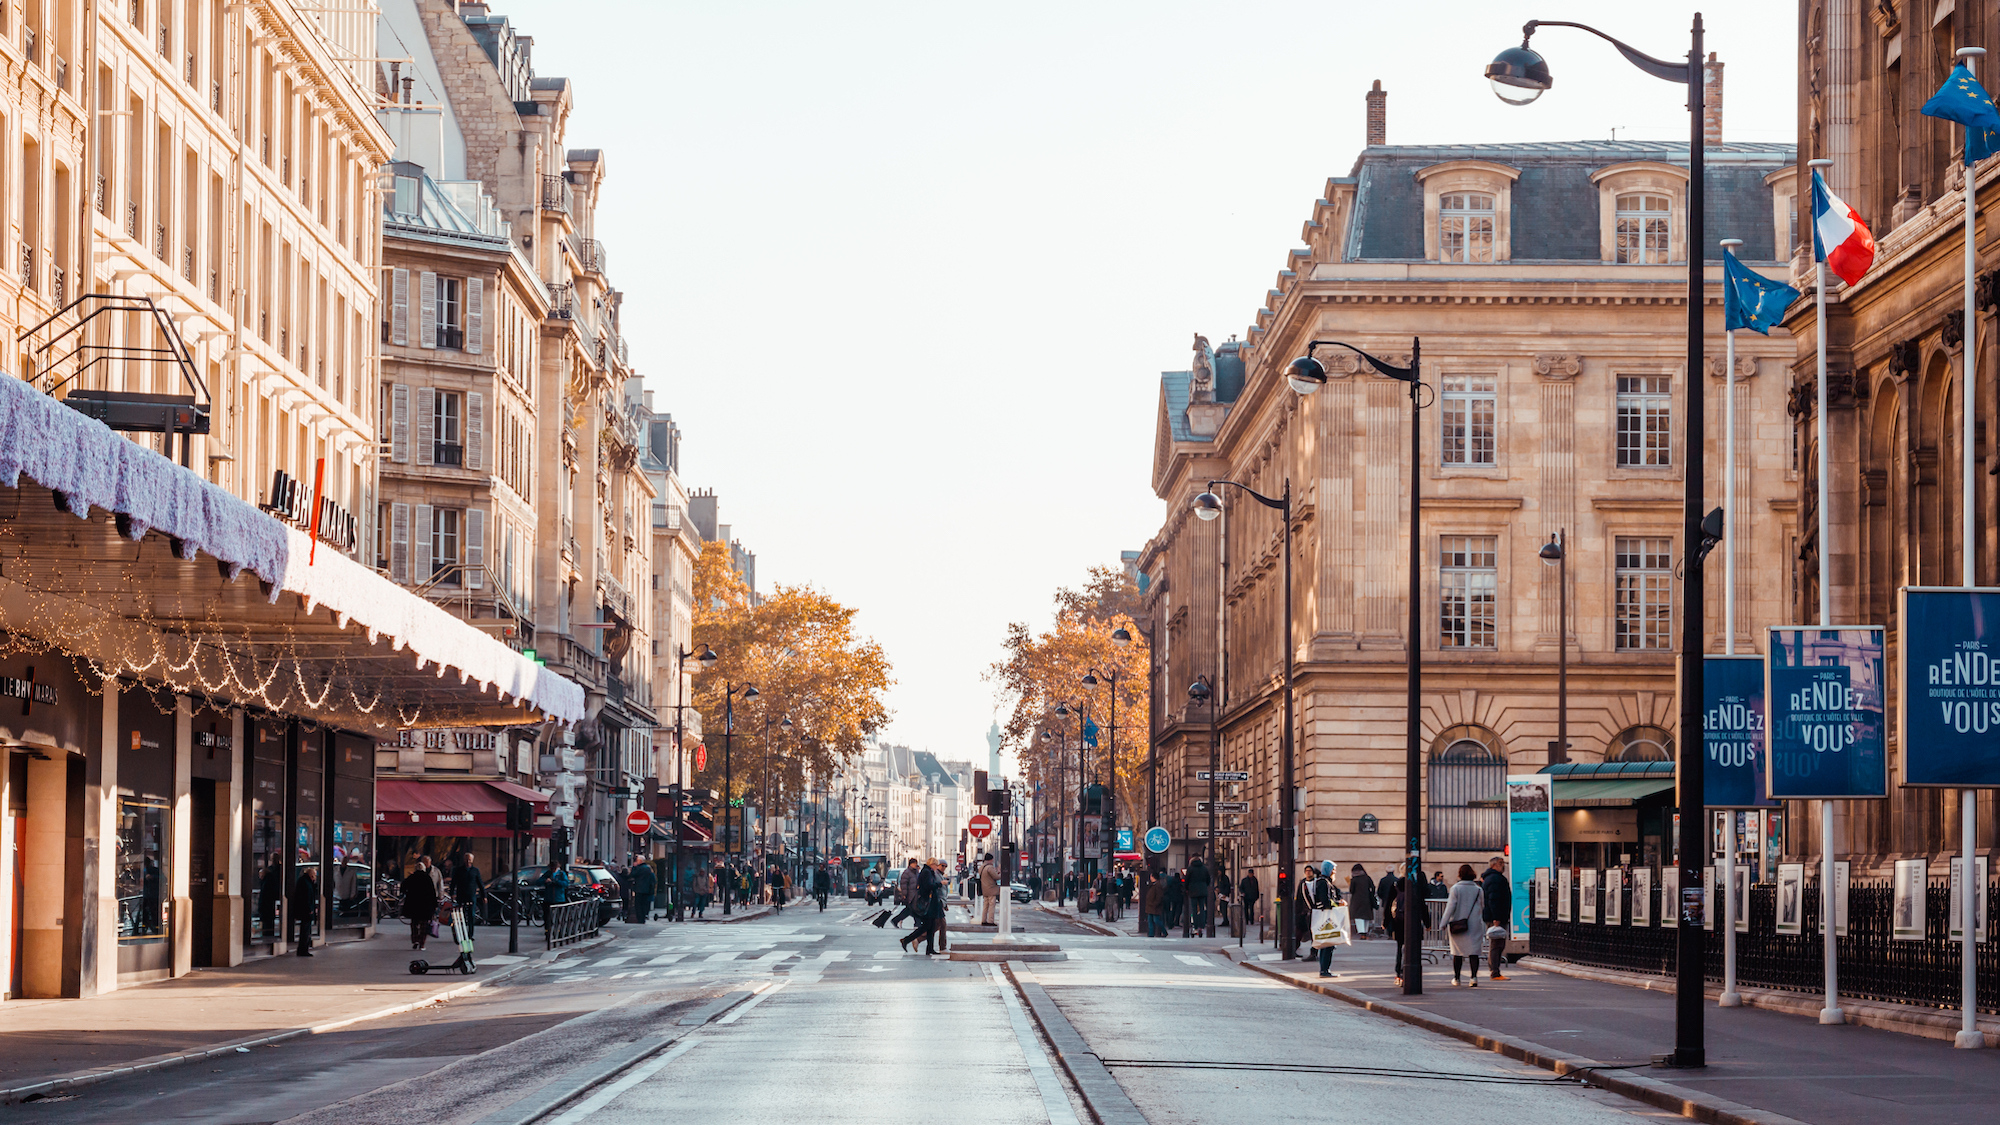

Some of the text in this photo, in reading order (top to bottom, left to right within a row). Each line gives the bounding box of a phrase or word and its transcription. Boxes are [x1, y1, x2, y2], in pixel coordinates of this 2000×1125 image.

[291, 479, 314, 529] BHV
[1963, 641, 1980, 650] PARIS
[1820, 672, 1835, 680] PARIS
[4, 676, 59, 706] LE BHV MARAIS
[1725, 695, 1739, 703] PARIS
[1790, 681, 1864, 711] RENDEZ
[1929, 688, 1957, 698] BOUTIQUE
[1957, 689, 1965, 698] DE
[1989, 689, 1997, 698] DE
[1790, 713, 1814, 722] BOUTIQUE
[1815, 713, 1822, 722] DE
[1843, 713, 1850, 722] DE
[1851, 713, 1864, 722] VILLE
[1941, 701, 2000, 734] VOUS
[426, 732, 446, 749] DE
[454, 733, 496, 750] VILLE
[1703, 732, 1720, 740] OUTIQUE
[1752, 732, 1764, 740] VILLE
[1802, 724, 1855, 753] VOUS
[1709, 742, 1756, 767] VOUS
